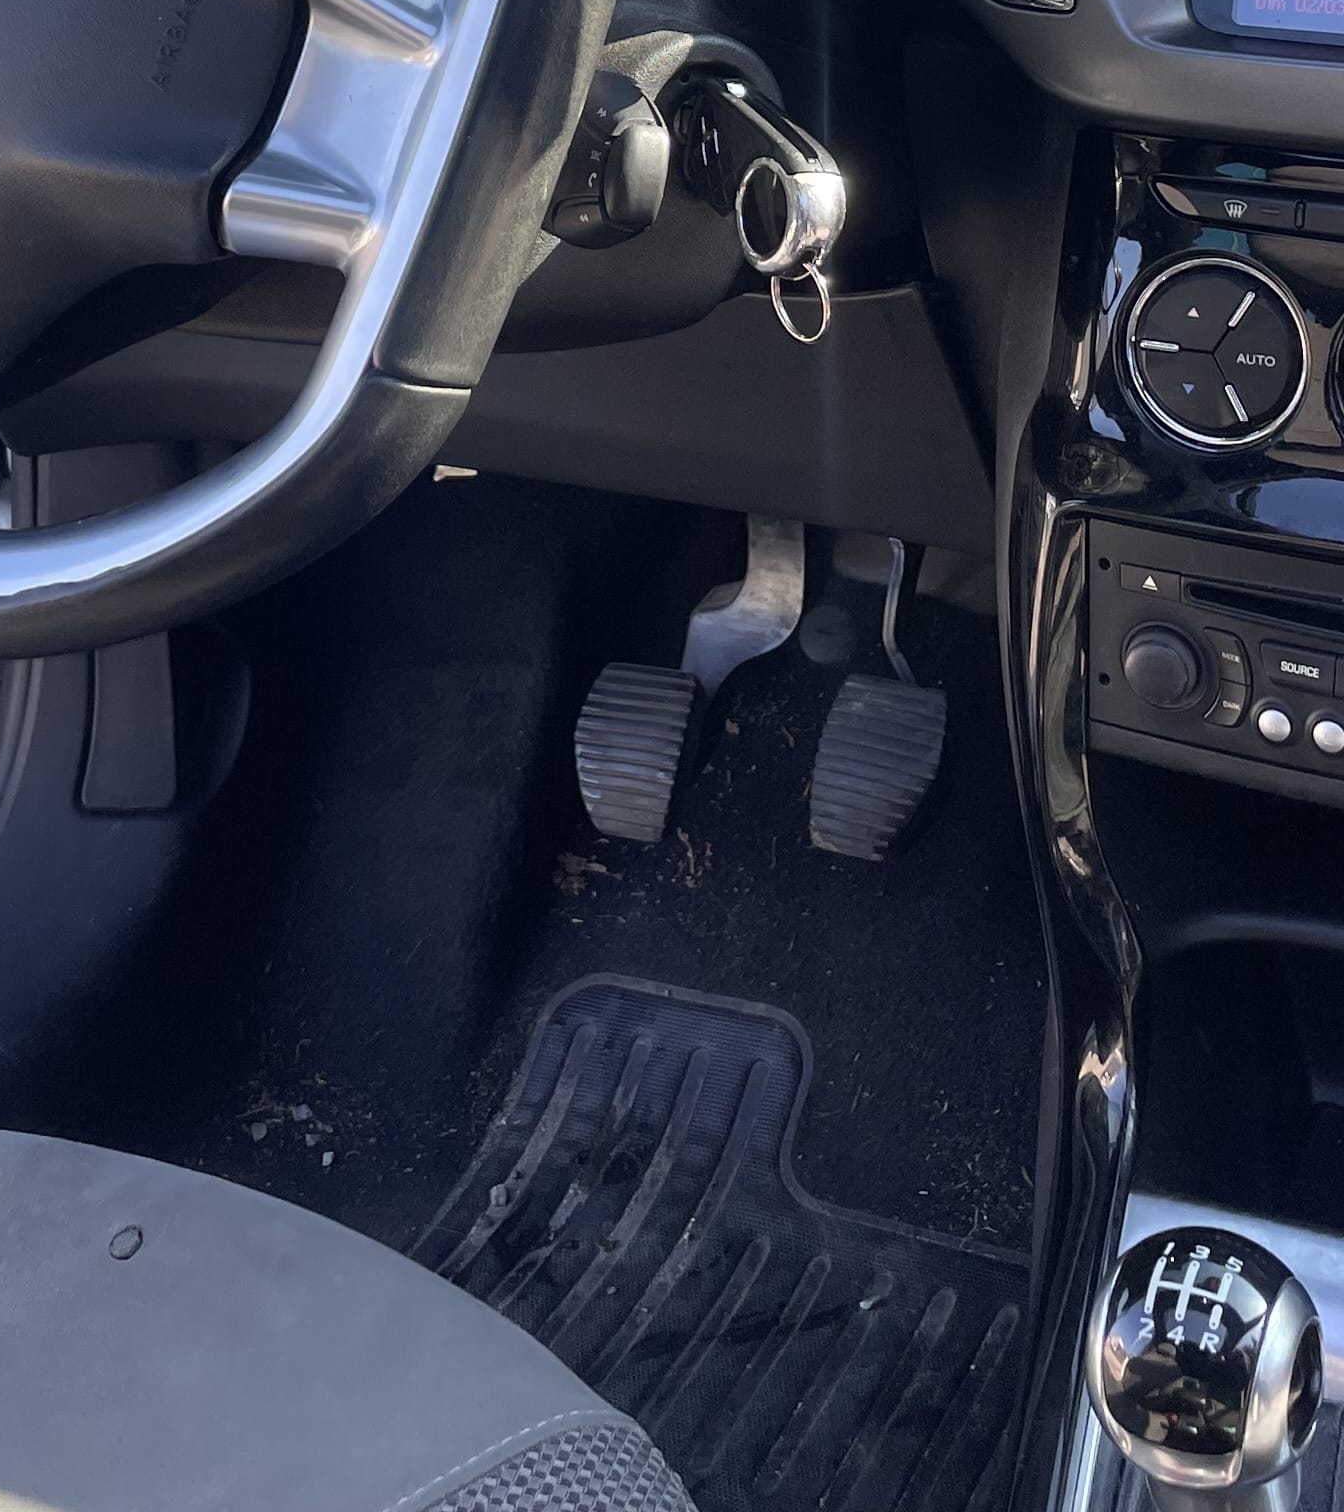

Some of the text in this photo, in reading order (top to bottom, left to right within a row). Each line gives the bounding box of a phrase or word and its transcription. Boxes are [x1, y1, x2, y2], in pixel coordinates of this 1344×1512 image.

[1236, 352, 1276, 367] AUTO
[1280, 660, 1320, 679] SOURCE
[1190, 1244, 1211, 1260] 3
[1225, 1256, 1244, 1272] 5
[1138, 1317, 1221, 1354] 2 4 R
